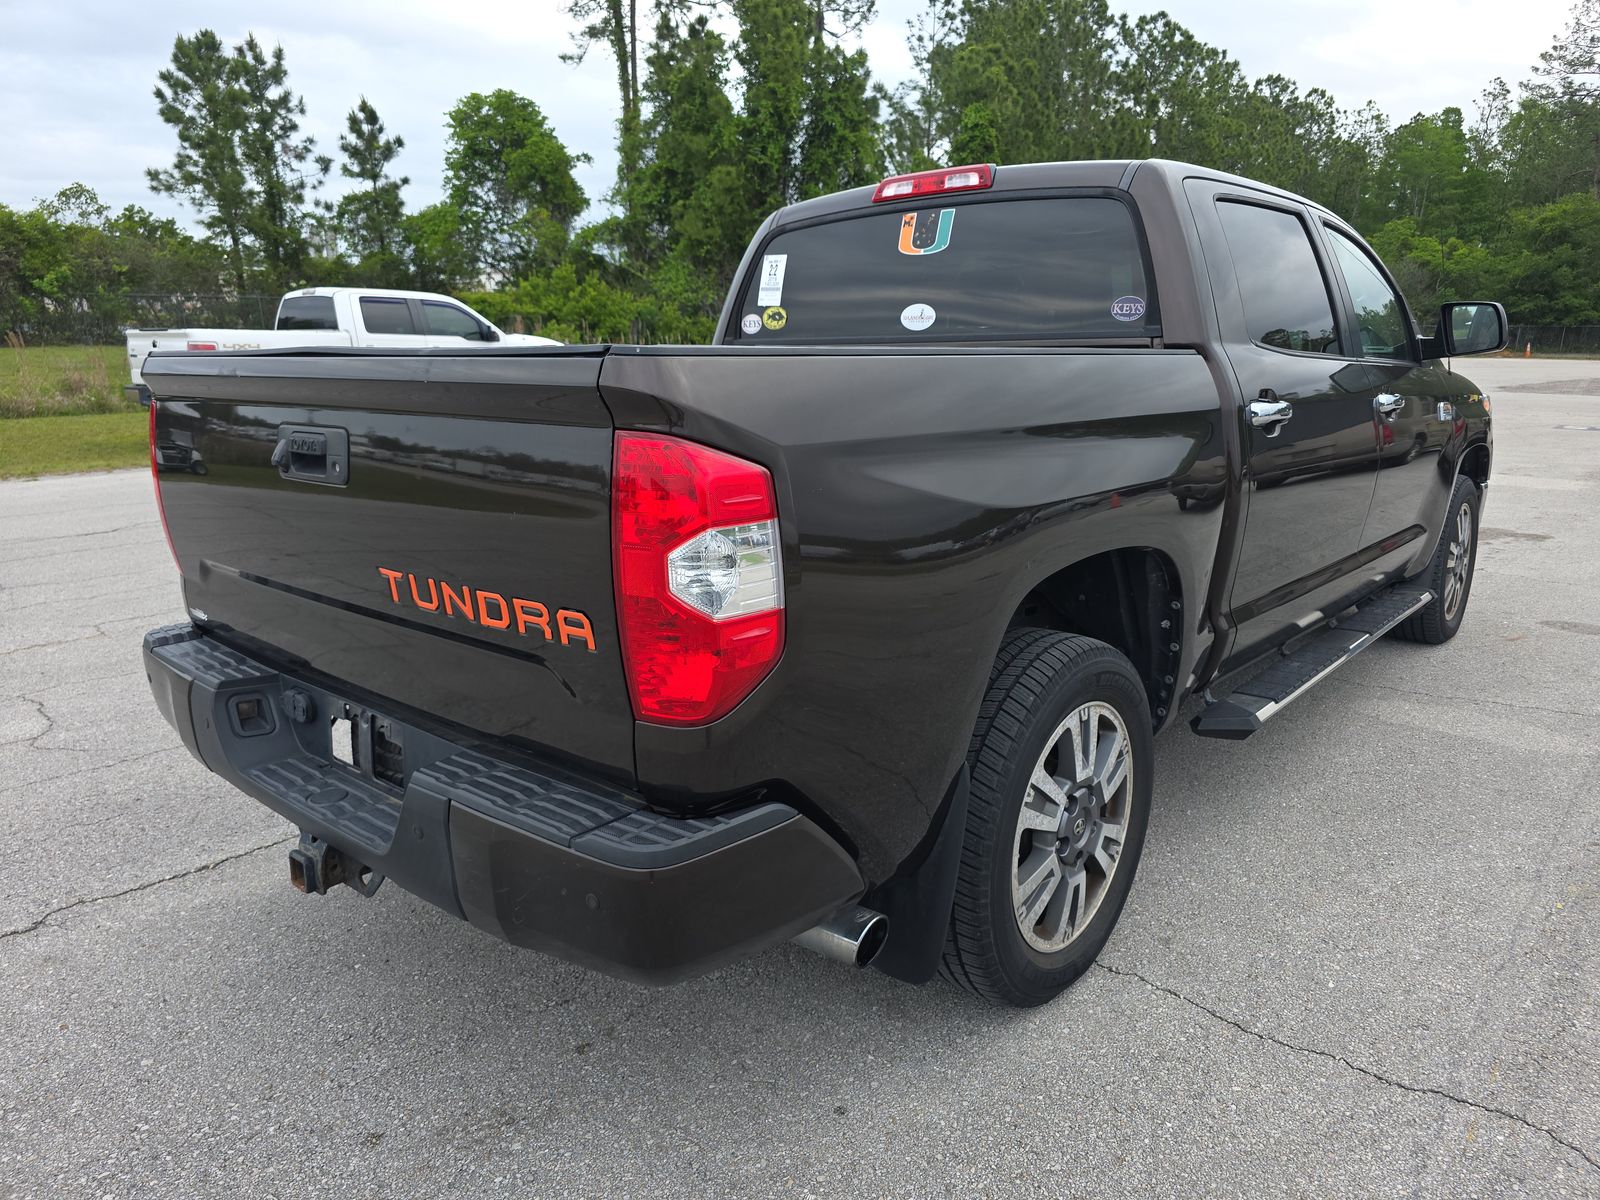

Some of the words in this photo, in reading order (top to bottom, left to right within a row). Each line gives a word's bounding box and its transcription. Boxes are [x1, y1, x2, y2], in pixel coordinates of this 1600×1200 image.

[898, 208, 956, 255] U
[1113, 303, 1144, 314] KEYS
[743, 320, 761, 328] KEYS
[289, 438, 320, 452] TOYOTA
[377, 566, 597, 652] TUNDRA
